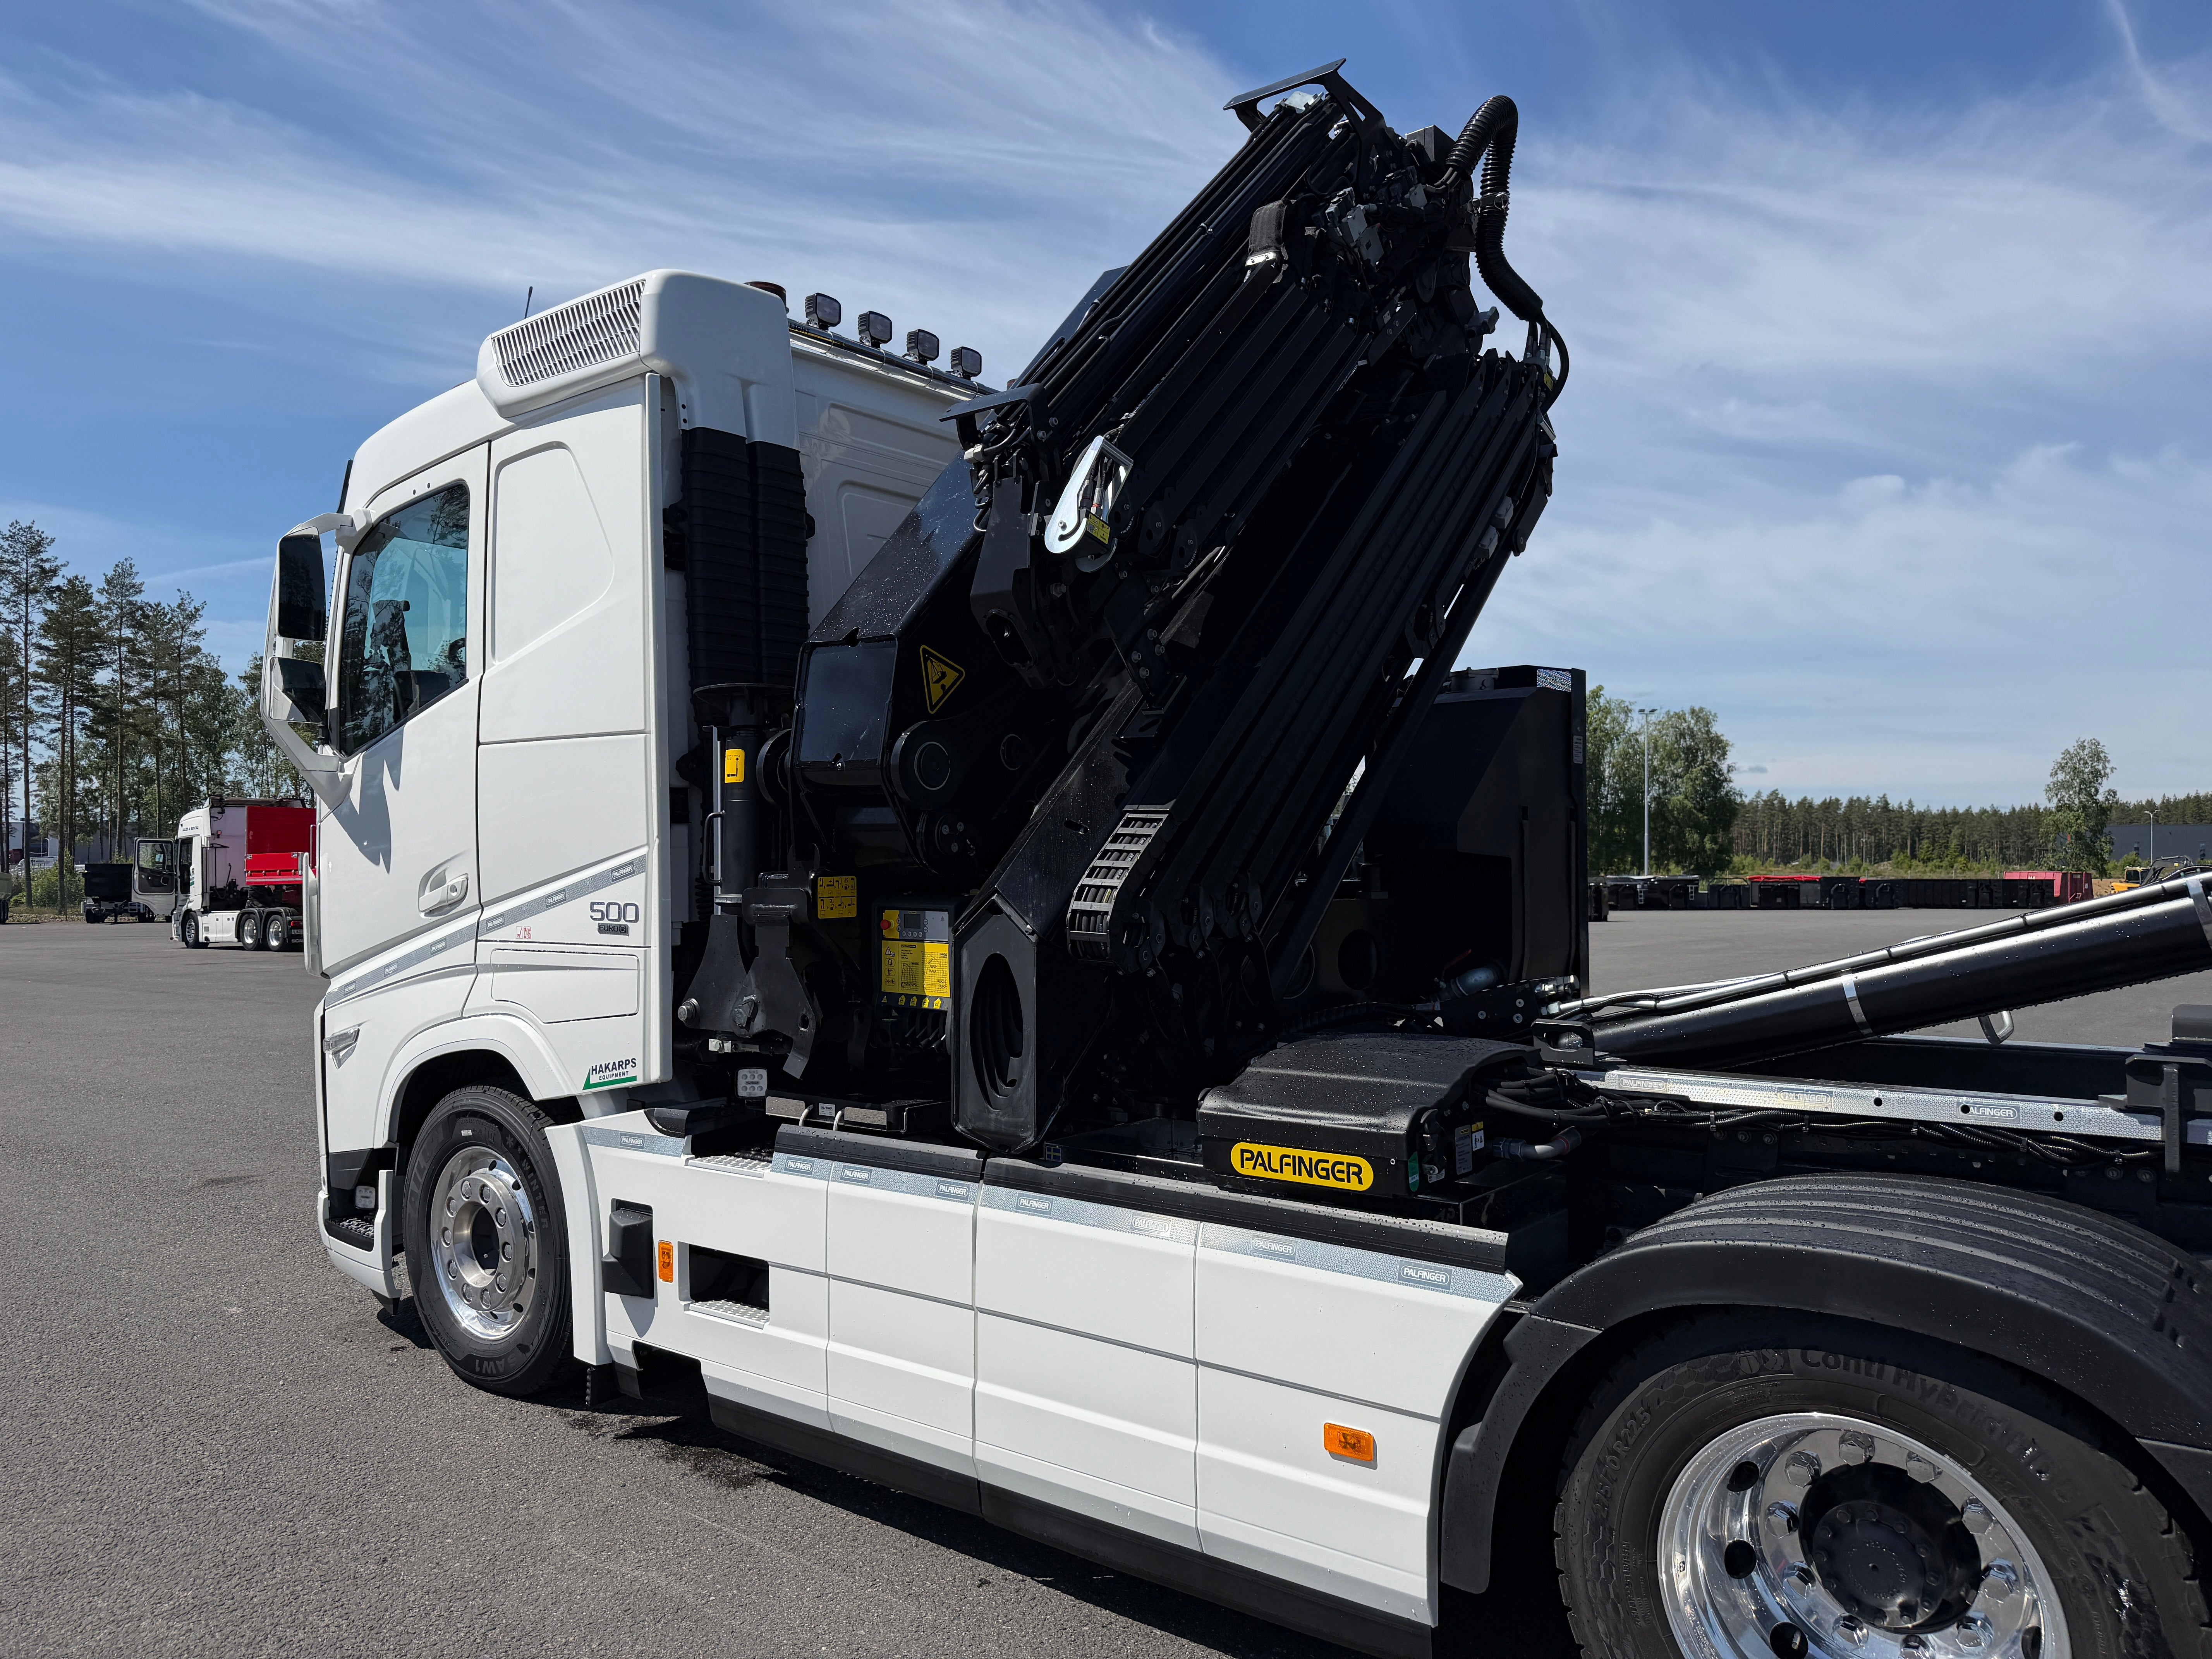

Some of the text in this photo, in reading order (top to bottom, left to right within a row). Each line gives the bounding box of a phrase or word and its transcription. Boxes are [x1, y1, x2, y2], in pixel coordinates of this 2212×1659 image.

[590, 902, 640, 923] 500
[591, 1058, 637, 1075] HAKARPS
[599, 1070, 629, 1080] EQUIPMENT
[1970, 1106, 2013, 1118] ALFINGER
[788, 1161, 811, 1170] PALFINGER
[1240, 1148, 1364, 1185] PALFINGER
[844, 1169, 869, 1180] PALFINGER
[939, 1185, 967, 1195] PALFINGER
[1020, 1199, 1049, 1209] PALFINGER
[1255, 1239, 1293, 1254] PALFINGER
[1403, 1267, 1446, 1283] PALFINGER
[475, 1353, 519, 1375] SAW1
